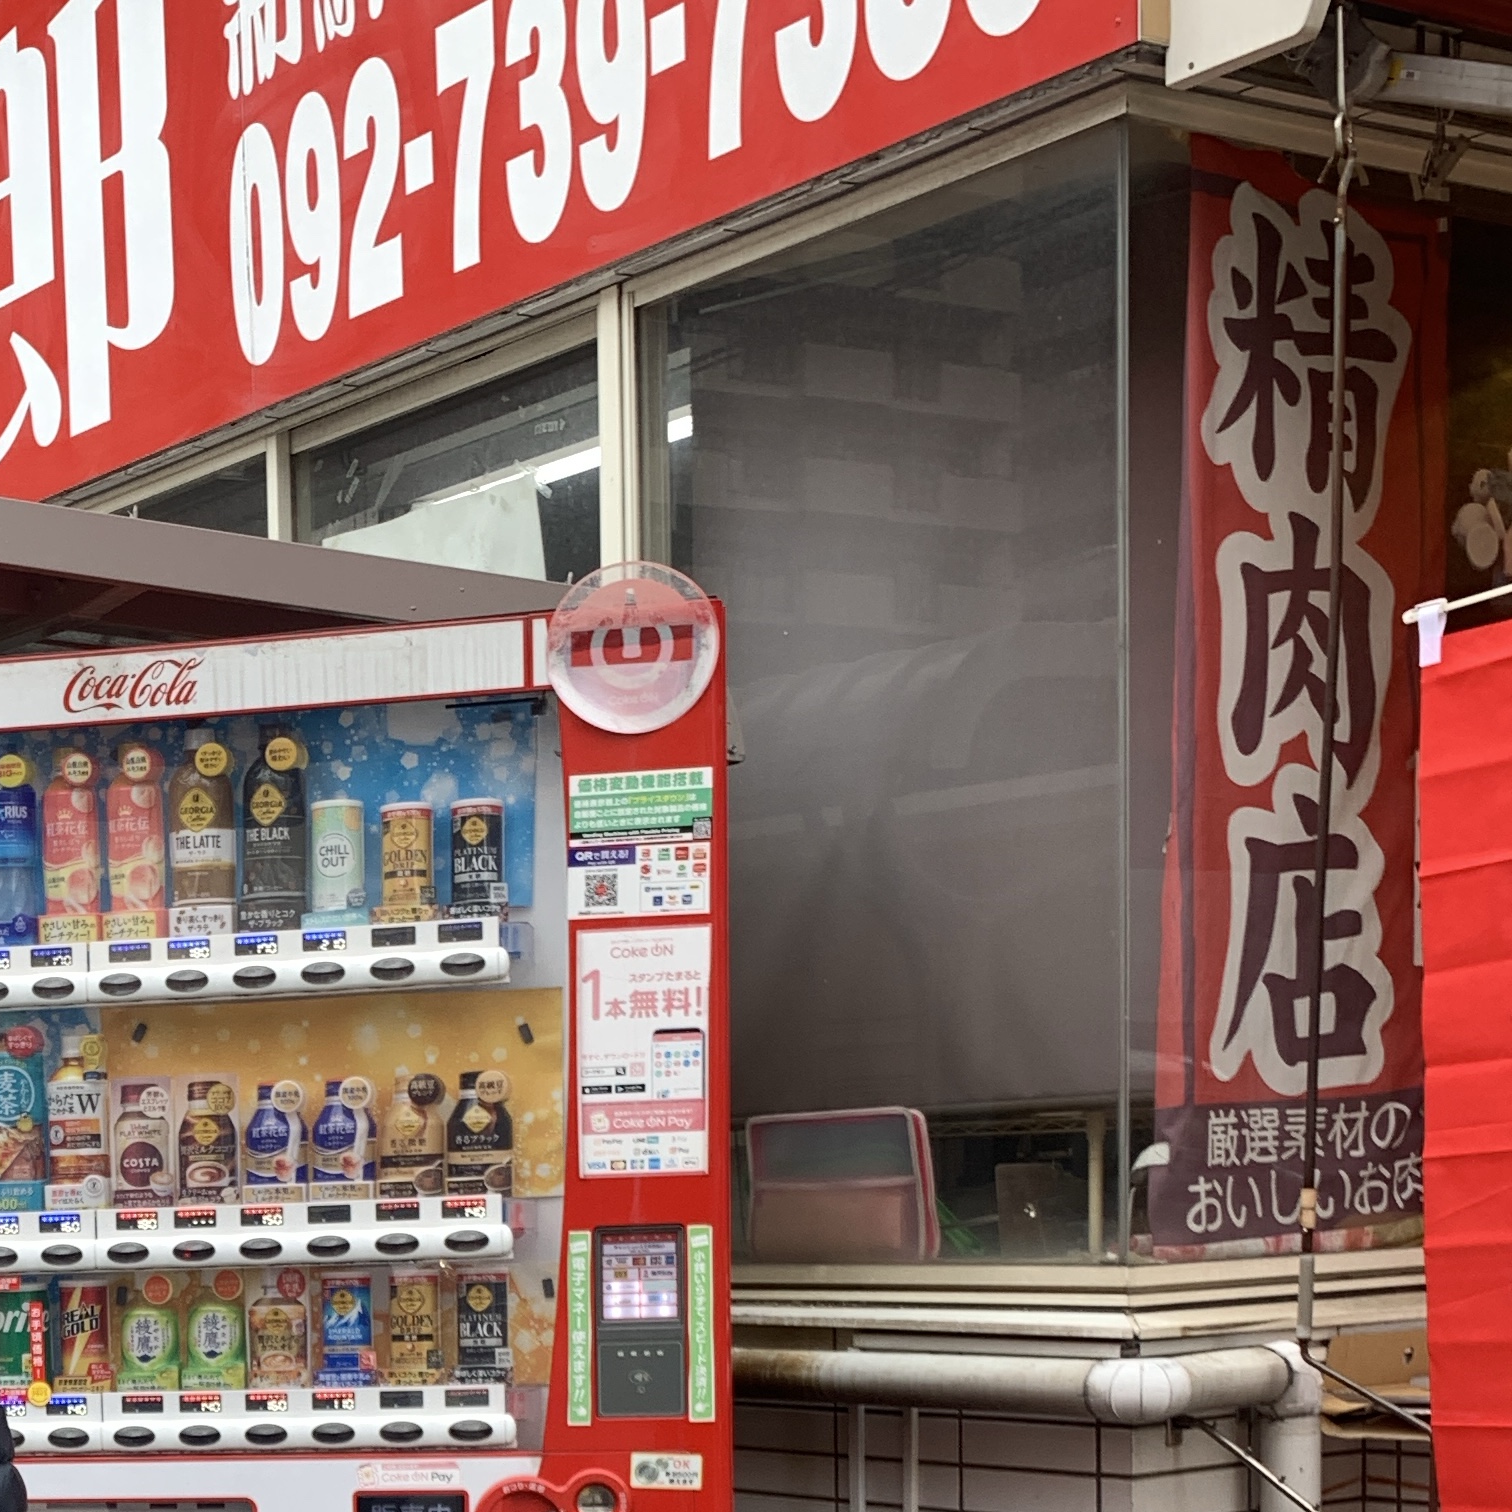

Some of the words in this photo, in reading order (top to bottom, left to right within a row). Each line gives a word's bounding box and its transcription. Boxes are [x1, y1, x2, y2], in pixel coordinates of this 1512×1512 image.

[1204, 184, 1412, 1094] 精肉店
[63, 657, 206, 713] Coca-Cola
[577, 770, 704, 794] 価格変動機能搭載
[180, 807, 215, 815] GEORGIA
[252, 800, 284, 808] GEORGIA
[246, 828, 259, 842] THE
[260, 827, 291, 841] BLACK
[176, 836, 190, 849] THE
[192, 835, 221, 849] LATTE
[319, 845, 350, 857] CHILL
[383, 849, 428, 867] GOLDEN
[574, 849, 630, 862] QRで買える!
[321, 856, 347, 868] OUT
[454, 855, 498, 873] BLACK
[42, 919, 96, 931] やさしい甘みの
[104, 917, 155, 928] やさしい甘みの
[610, 944, 648, 959] Coke
[629, 970, 701, 984] スタンプたまると
[581, 968, 703, 1022] 1本無料!
[74, 1092, 101, 1114] W
[613, 1117, 645, 1129] Coke
[668, 1115, 693, 1129] Pay
[1206, 1100, 1412, 1169] 厳選素材の
[123, 1158, 159, 1168] COSTA
[587, 1161, 607, 1170] VISA
[62, 1302, 99, 1323] REAL
[62, 1317, 100, 1340] GOLD
[459, 1321, 503, 1338] BLACK
[382, 1472, 410, 1483] Coke
[431, 1471, 453, 1484] Pay
